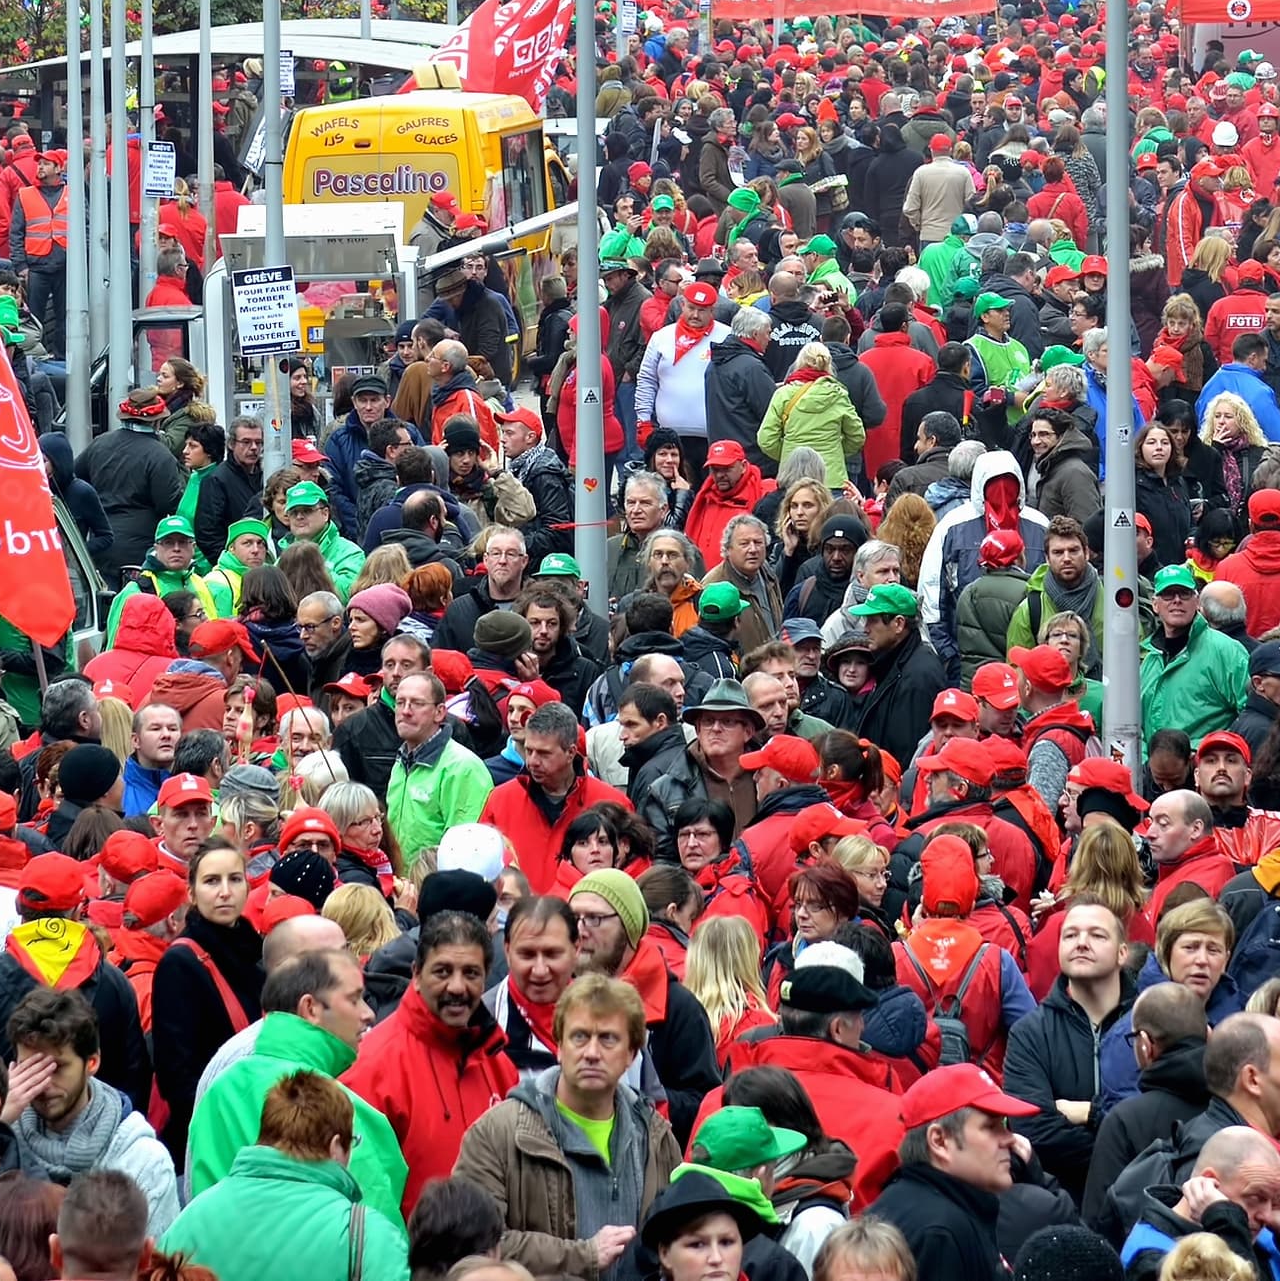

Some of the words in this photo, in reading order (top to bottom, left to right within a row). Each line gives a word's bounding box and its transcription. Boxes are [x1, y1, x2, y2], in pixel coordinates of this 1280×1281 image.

[310, 117, 360, 138] WAFELS
[397, 117, 450, 134] GAUFRES
[324, 133, 345, 147] IJS
[414, 133, 458, 146] GLACES
[314, 166, 448, 196] Pascalino
[244, 271, 283, 284] GRÈVE
[238, 287, 263, 296] POUR
[266, 285, 291, 294] FAIRE
[246, 294, 285, 304] TOMBER
[253, 321, 284, 331] TOUTE
[1229, 316, 1261, 327] FGTB
